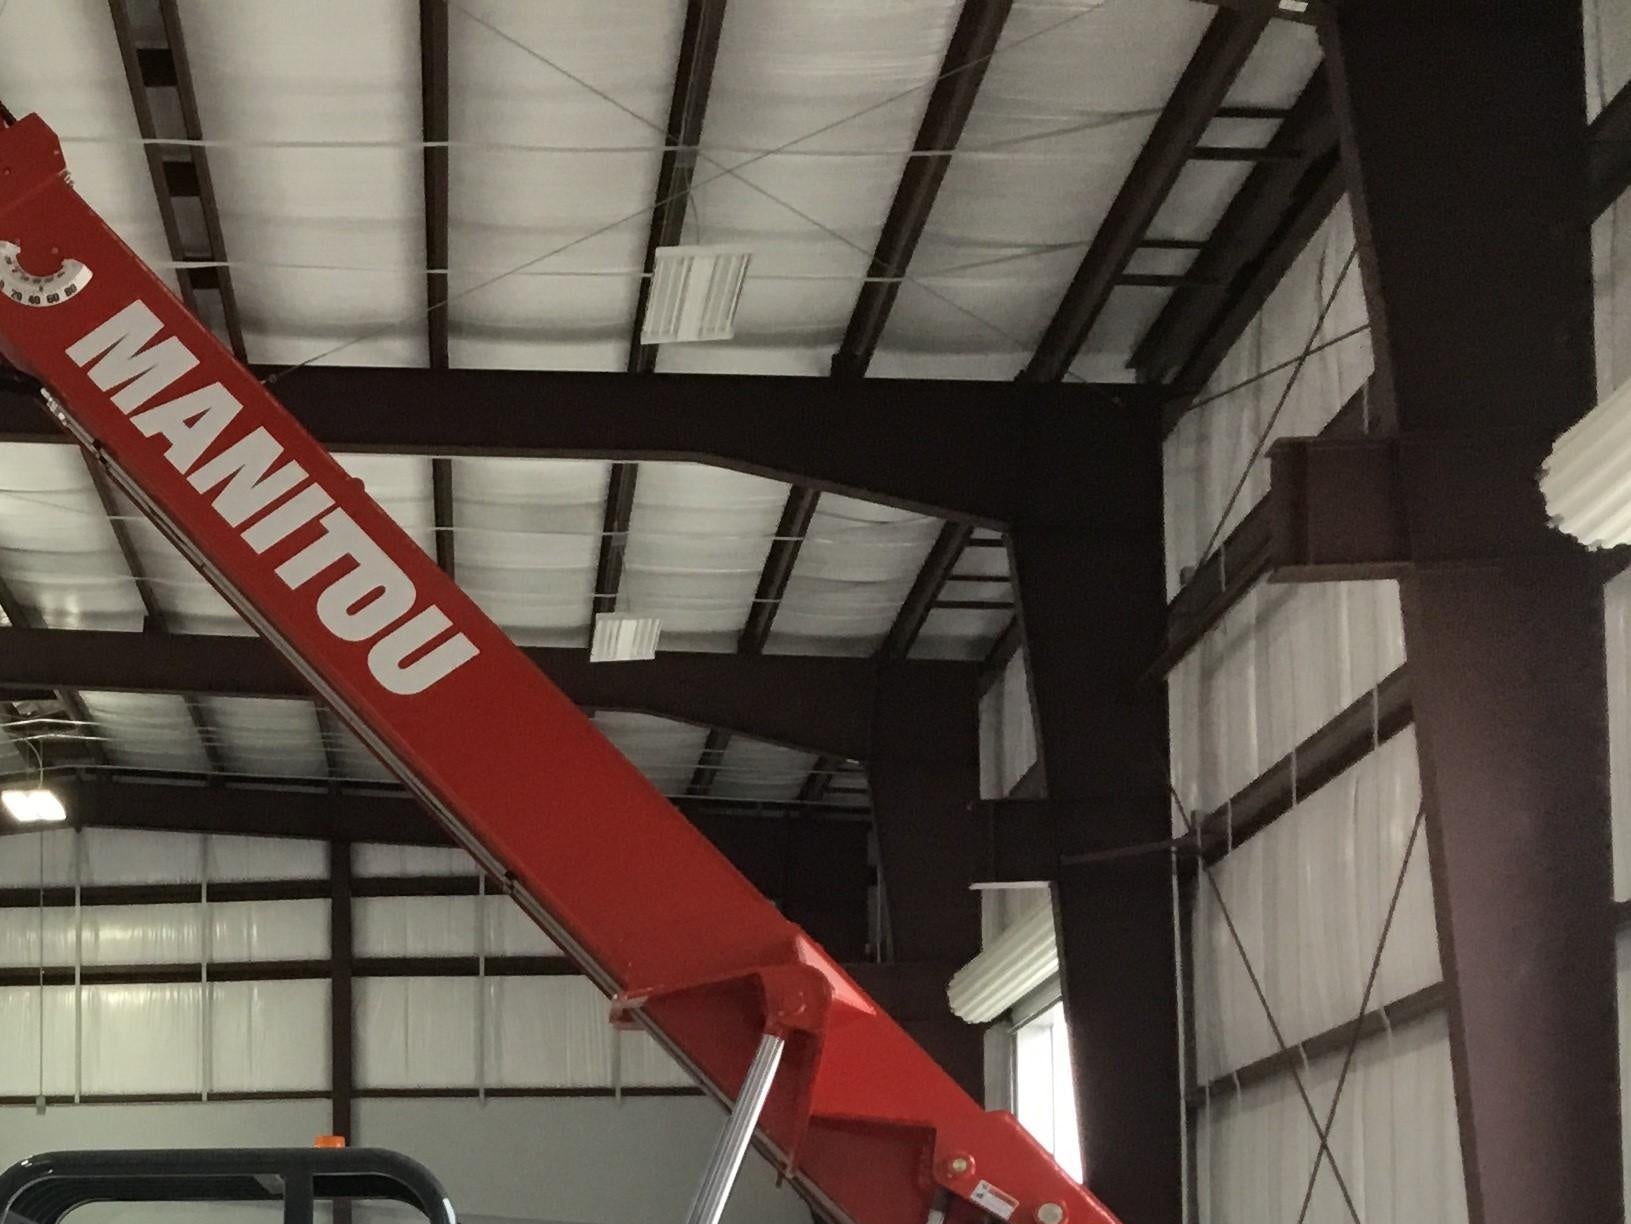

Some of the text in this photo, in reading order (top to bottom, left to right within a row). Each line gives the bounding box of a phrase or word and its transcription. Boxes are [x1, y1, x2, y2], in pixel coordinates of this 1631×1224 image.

[28, 295, 41, 305] 40
[46, 293, 60, 303] 60
[64, 283, 77, 297] 80
[65, 299, 479, 695] MANITOU
